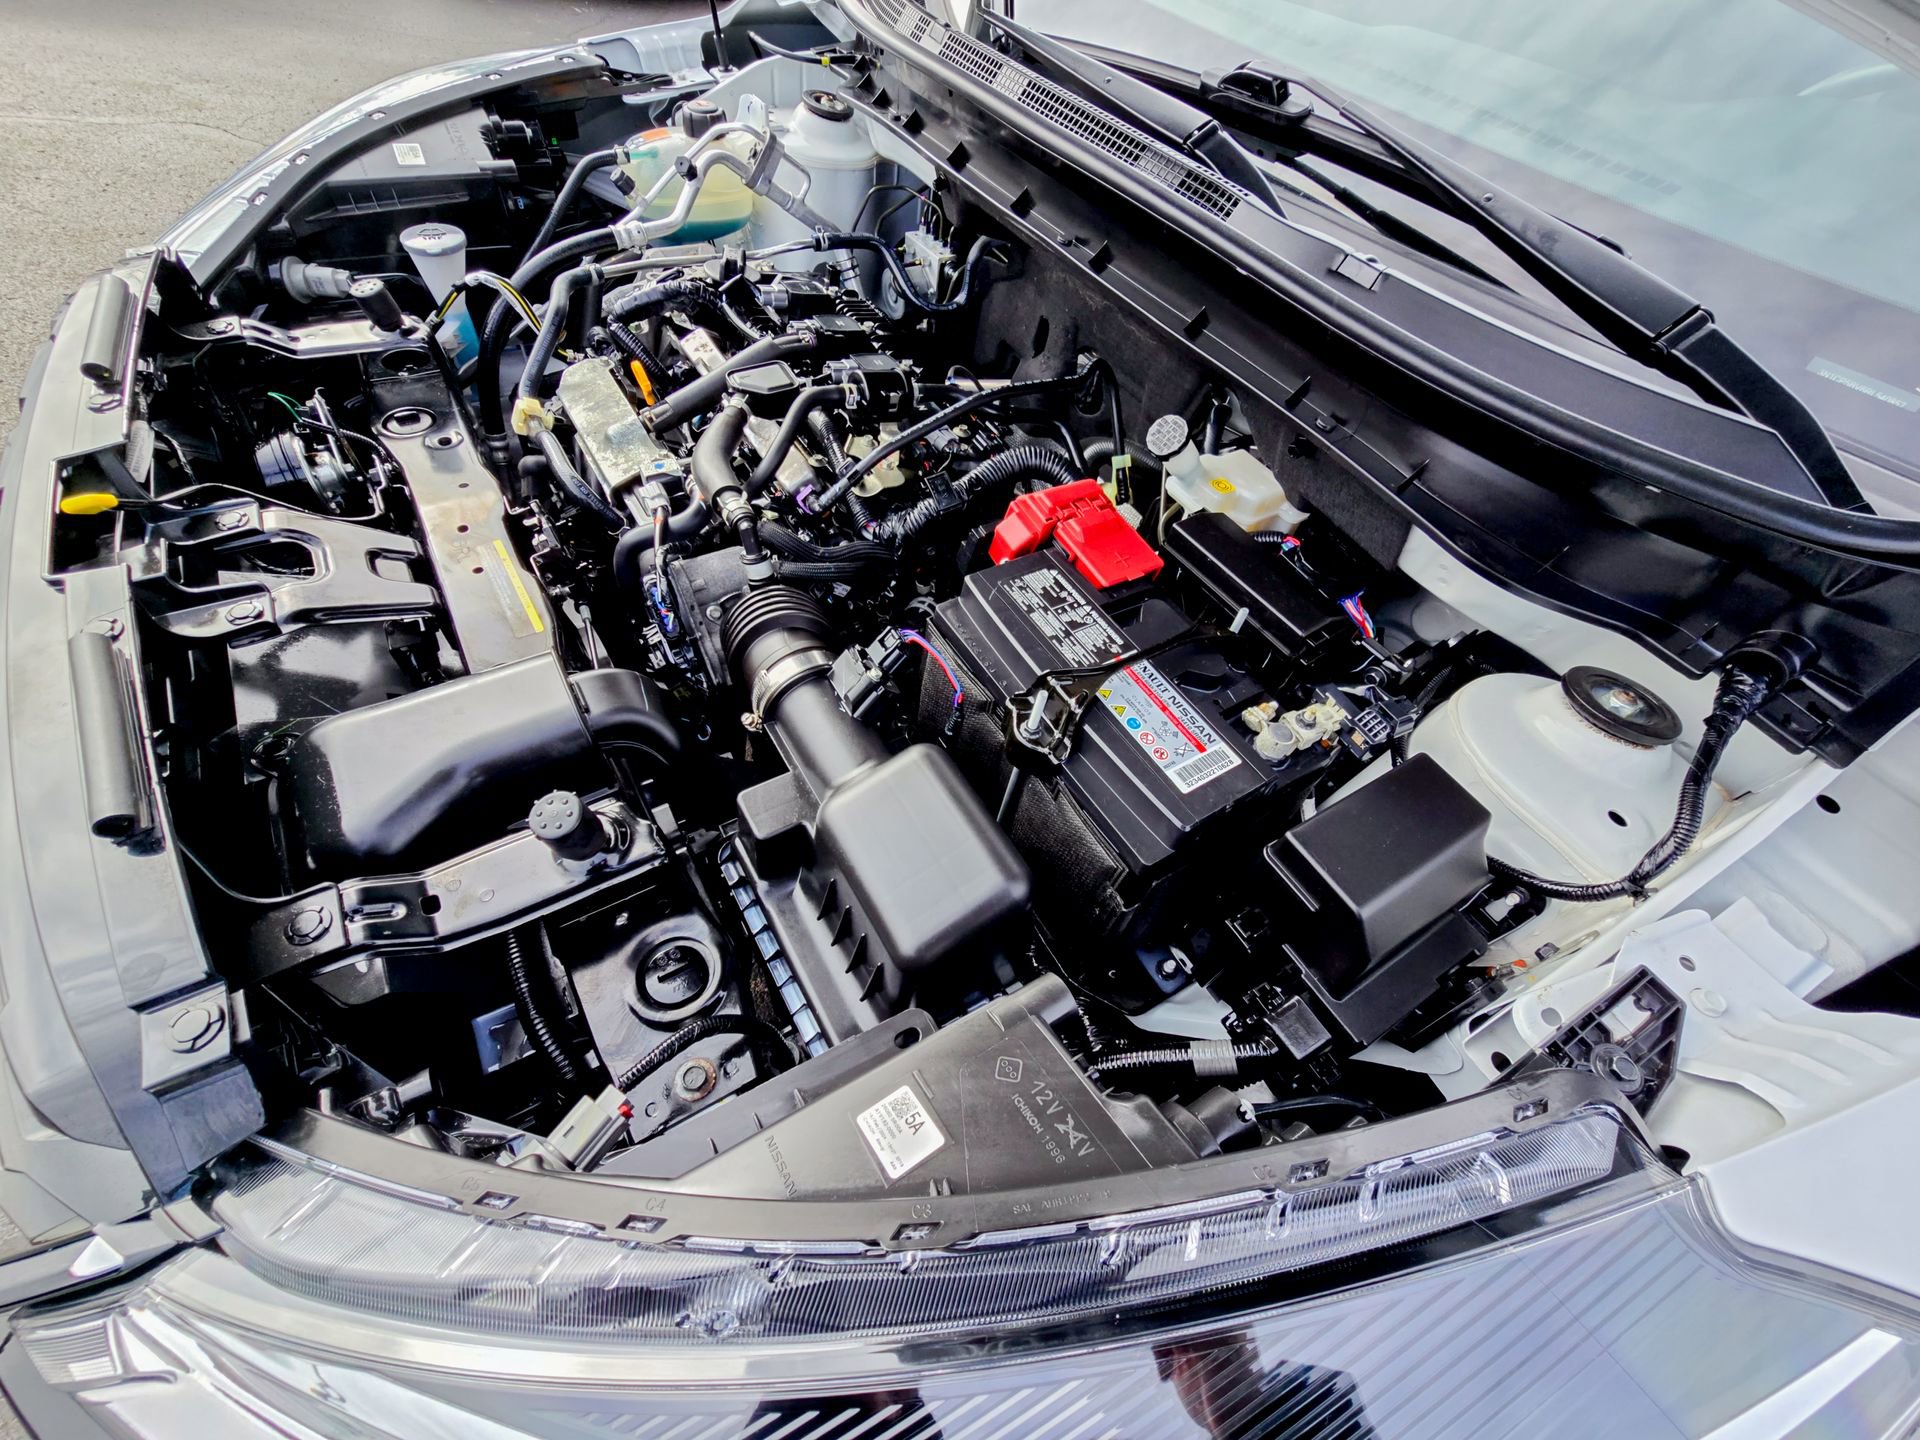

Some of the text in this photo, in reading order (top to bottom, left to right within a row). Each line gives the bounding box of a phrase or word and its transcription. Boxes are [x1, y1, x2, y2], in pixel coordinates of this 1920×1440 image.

[1137, 663, 1216, 744] NAULT NISSAN
[905, 1111, 925, 1135] 5A
[1011, 1093, 1066, 1164] ICHIKOH 1996
[1029, 1080, 1064, 1116] 12V
[764, 1134, 798, 1198] NISSAN
